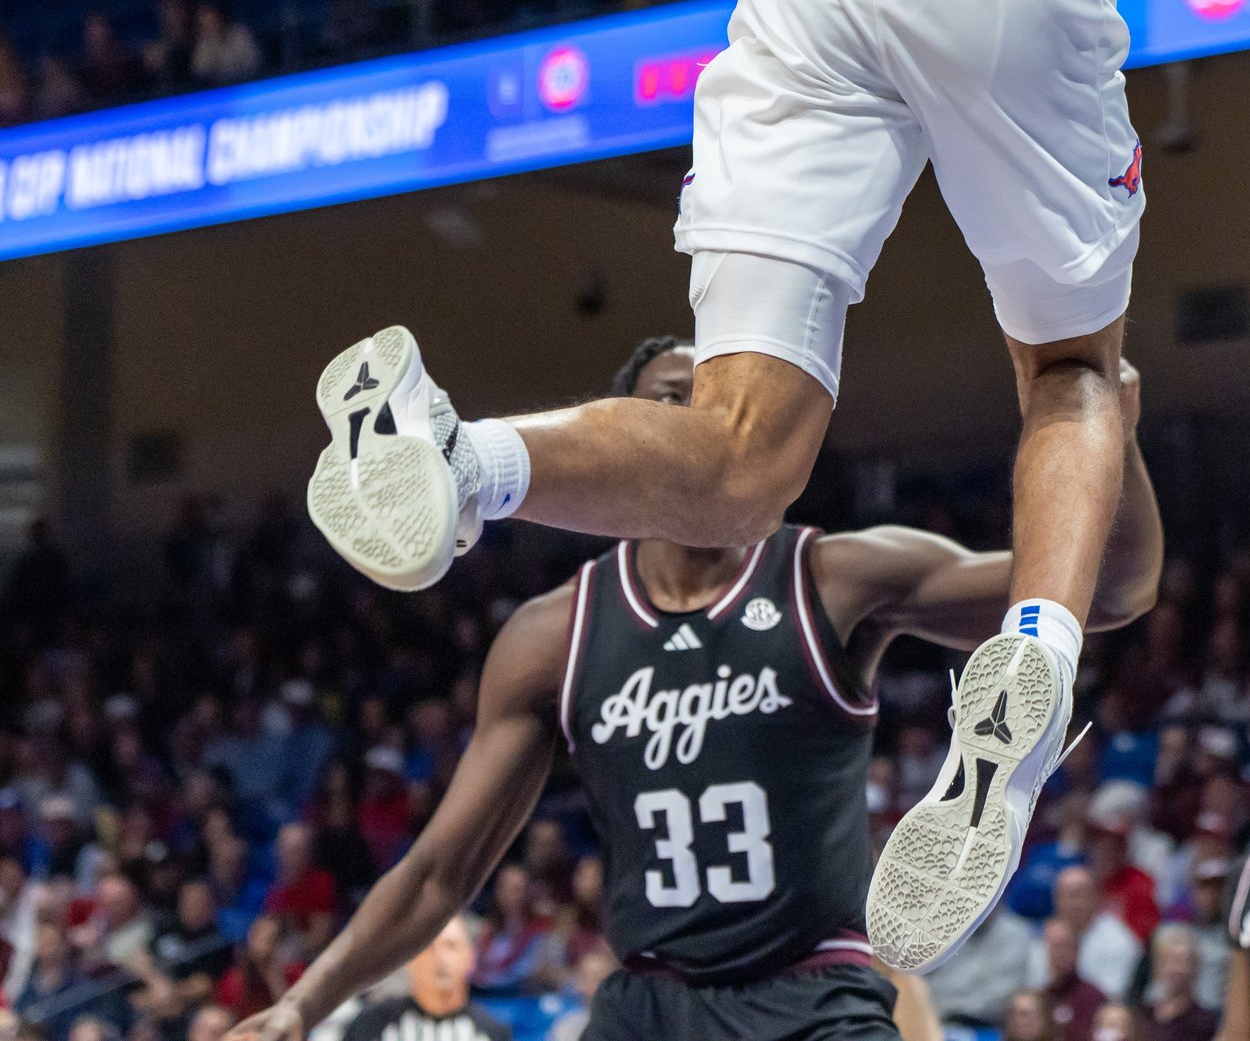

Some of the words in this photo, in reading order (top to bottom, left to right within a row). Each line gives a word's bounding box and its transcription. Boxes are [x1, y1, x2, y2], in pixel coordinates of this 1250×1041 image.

[207, 83, 446, 182] CHAMPIONSHIP
[592, 665, 793, 770] Aggies
[634, 781, 776, 908] 33
